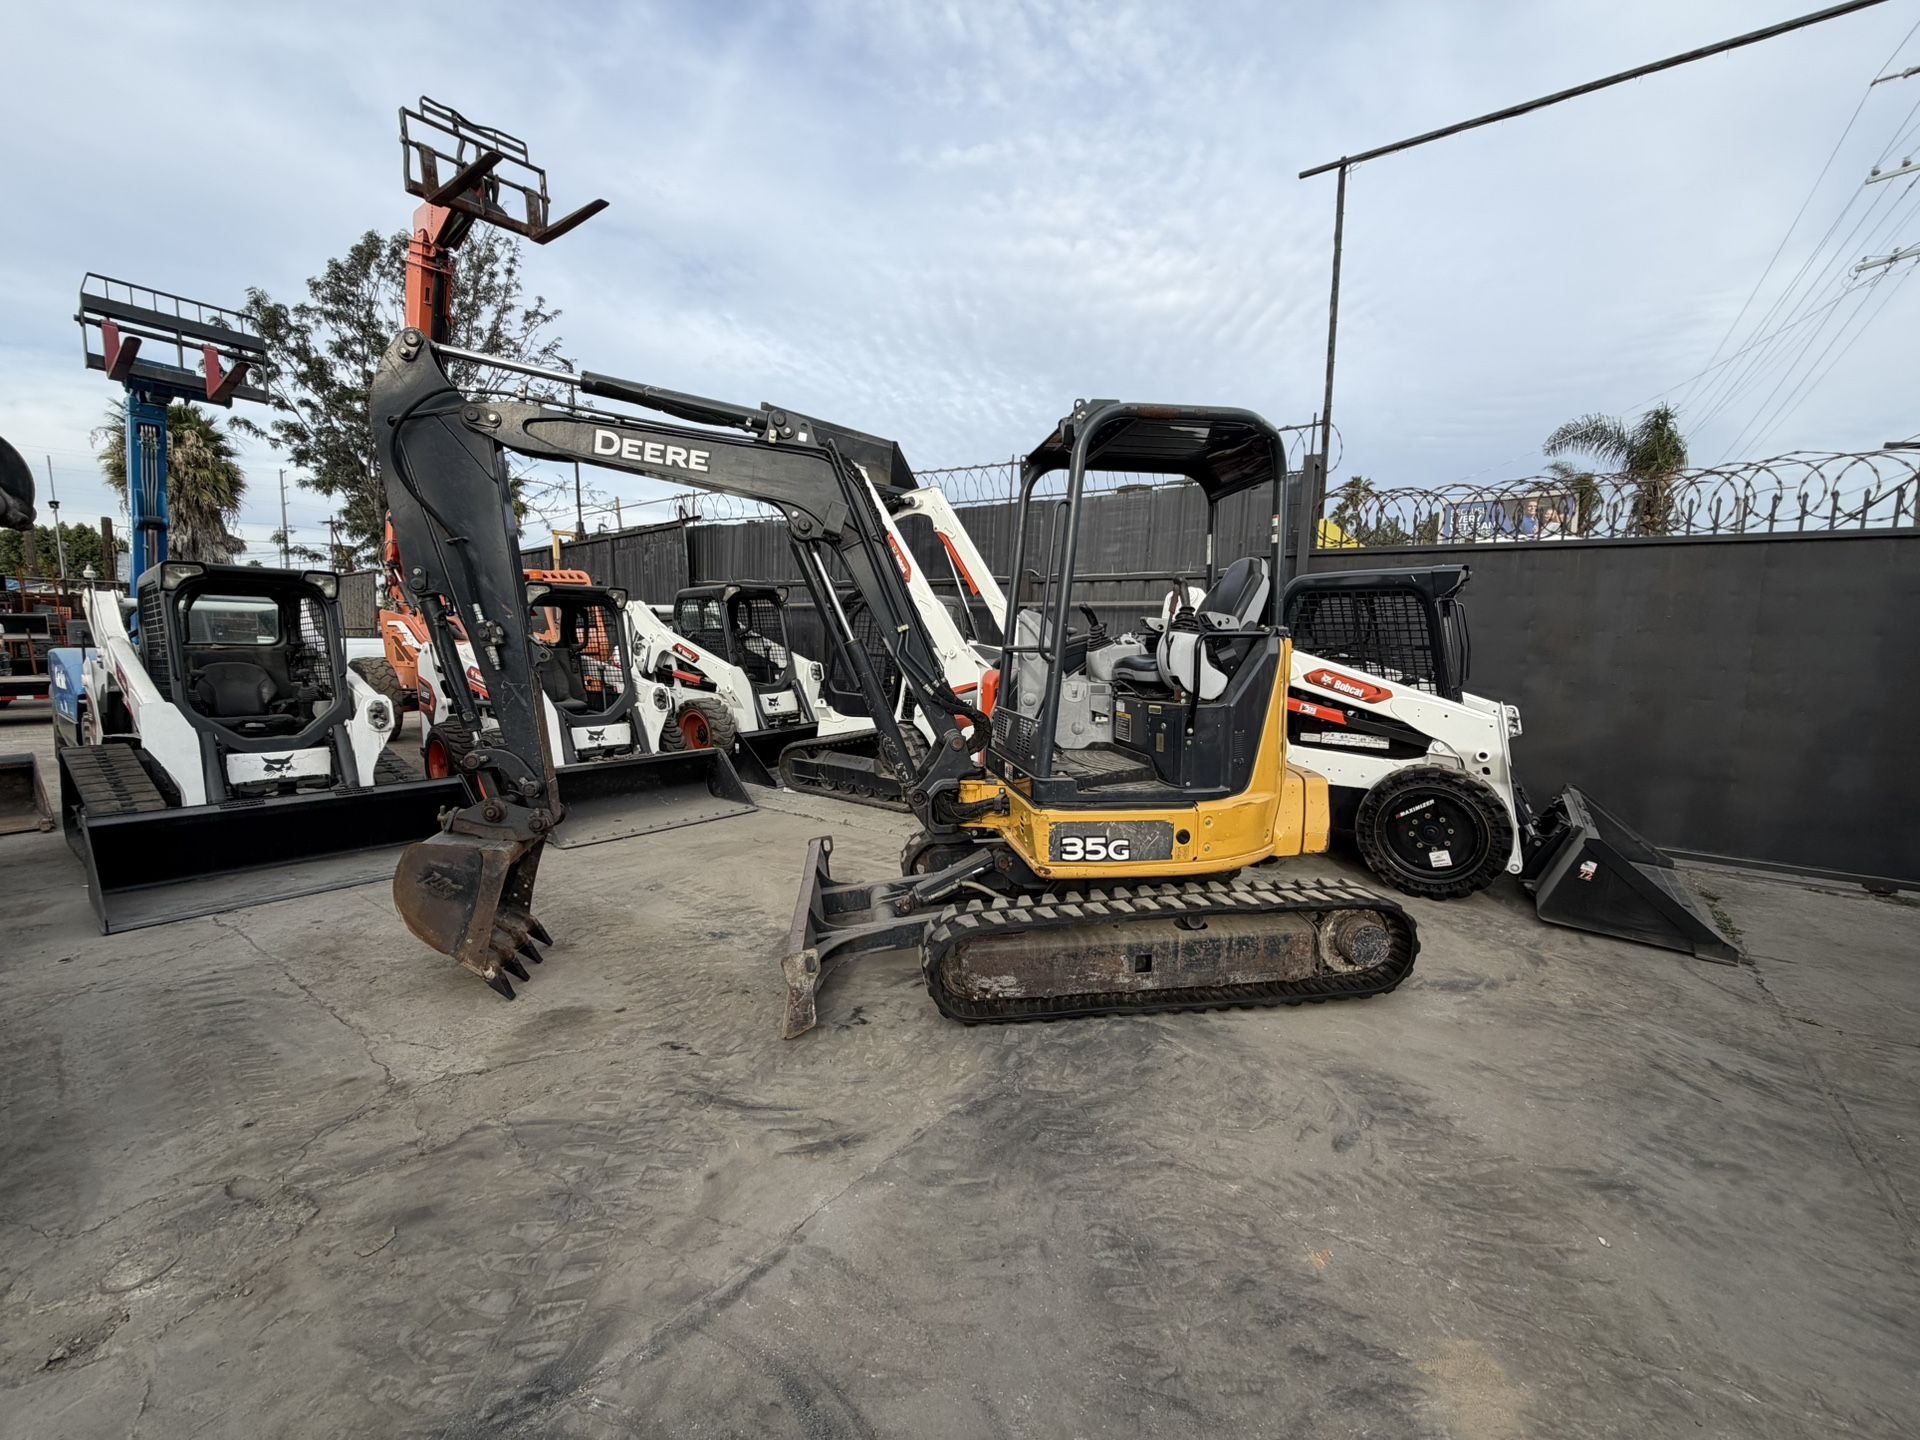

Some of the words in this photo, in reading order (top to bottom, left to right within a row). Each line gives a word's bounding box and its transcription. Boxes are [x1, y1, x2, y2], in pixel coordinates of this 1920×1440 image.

[594, 429, 710, 472] DEERE
[1334, 680, 1364, 697] Bobcat
[1400, 799, 1435, 817] MAXIMIZER
[1061, 837, 1130, 861] 35G
